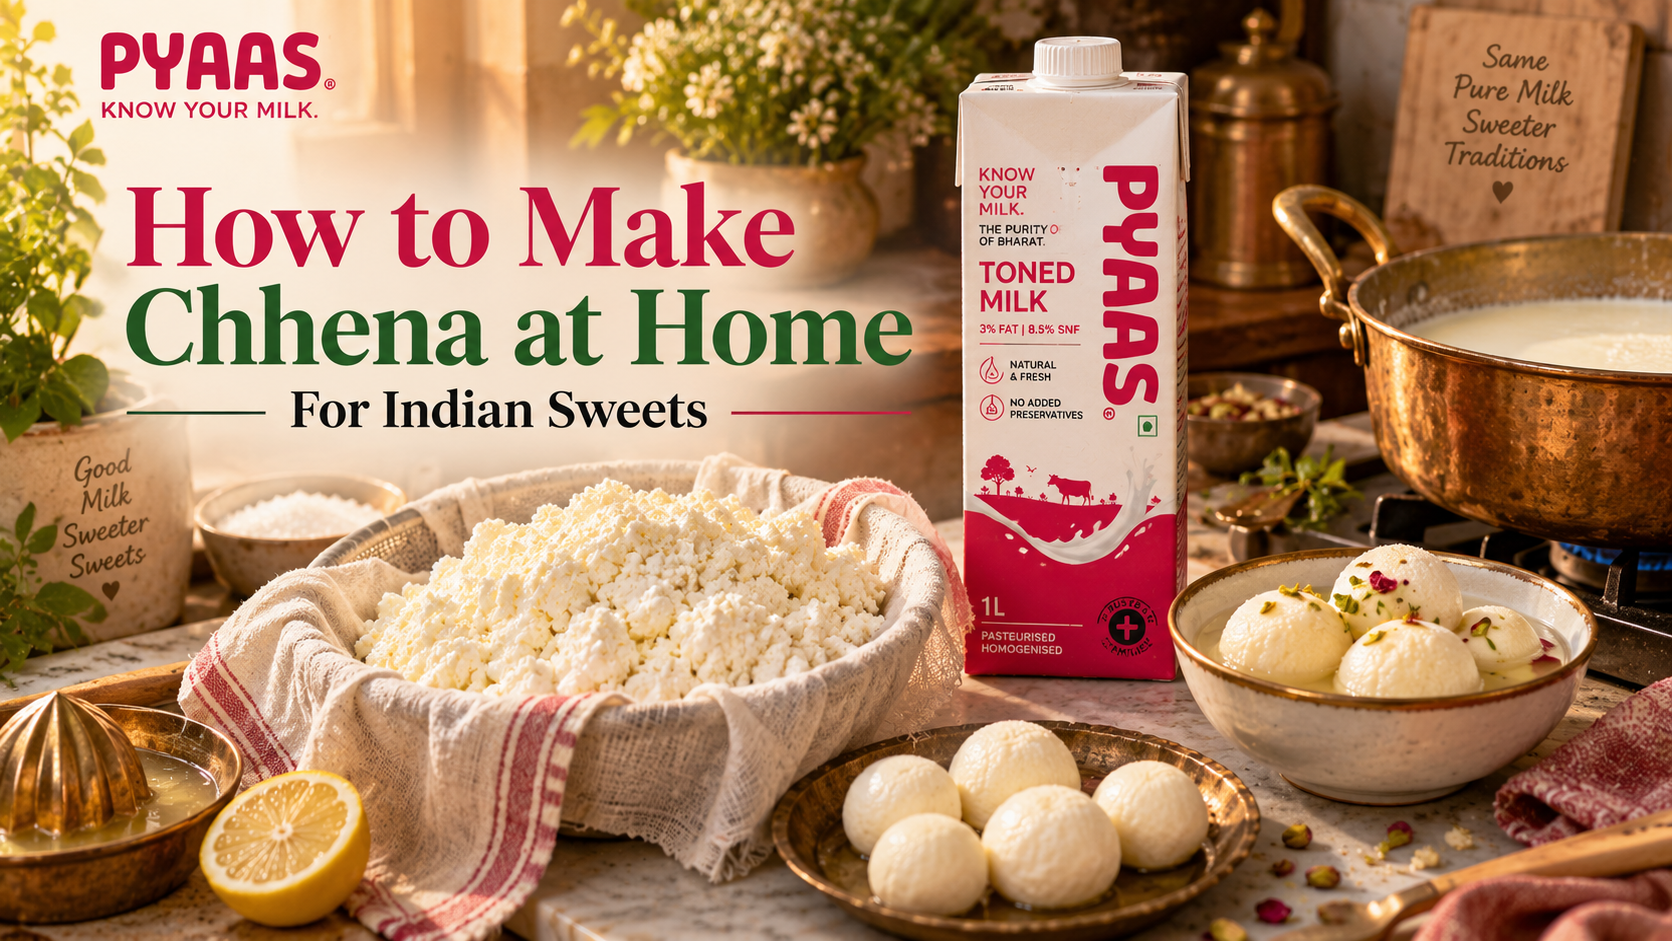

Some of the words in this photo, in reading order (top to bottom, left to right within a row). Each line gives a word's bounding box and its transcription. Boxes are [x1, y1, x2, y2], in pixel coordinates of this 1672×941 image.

[1483, 44, 1549, 71] Same
[1454, 74, 1509, 101] Pure
[1517, 80, 1573, 106] Milk
[1463, 109, 1556, 138] Sweeter
[1445, 141, 1569, 173] Traditions
[979, 168, 1035, 181] KNOW
[979, 185, 1027, 199] YOUR
[980, 203, 1024, 215] MILK.
[979, 225, 1001, 234] THE
[1006, 225, 1048, 234] PURITY
[980, 237, 994, 246] OF
[998, 236, 1046, 247] BHARAT.
[979, 261, 1075, 283] TONED
[1103, 166, 1159, 405] PYAAS
[981, 290, 1047, 312] MILK
[980, 324, 996, 333] 3%
[999, 324, 1018, 334] FAT
[1028, 324, 1054, 334] 8.5%
[1058, 325, 1080, 334] SNF
[1011, 361, 1056, 369] NATURAL
[1021, 373, 1050, 381] FRESH
[1011, 399, 1025, 407] NO
[1028, 399, 1061, 407] ADDED
[1010, 410, 1083, 420] PRESERVATIVES
[74, 448, 132, 488] Good
[81, 481, 132, 515] Milk
[62, 515, 150, 548] Sweeter
[69, 545, 146, 579] Sweets
[982, 597, 1004, 616] 1L
[982, 632, 1055, 642] PASTEURISED
[982, 644, 1062, 654] HOMOGENISED
